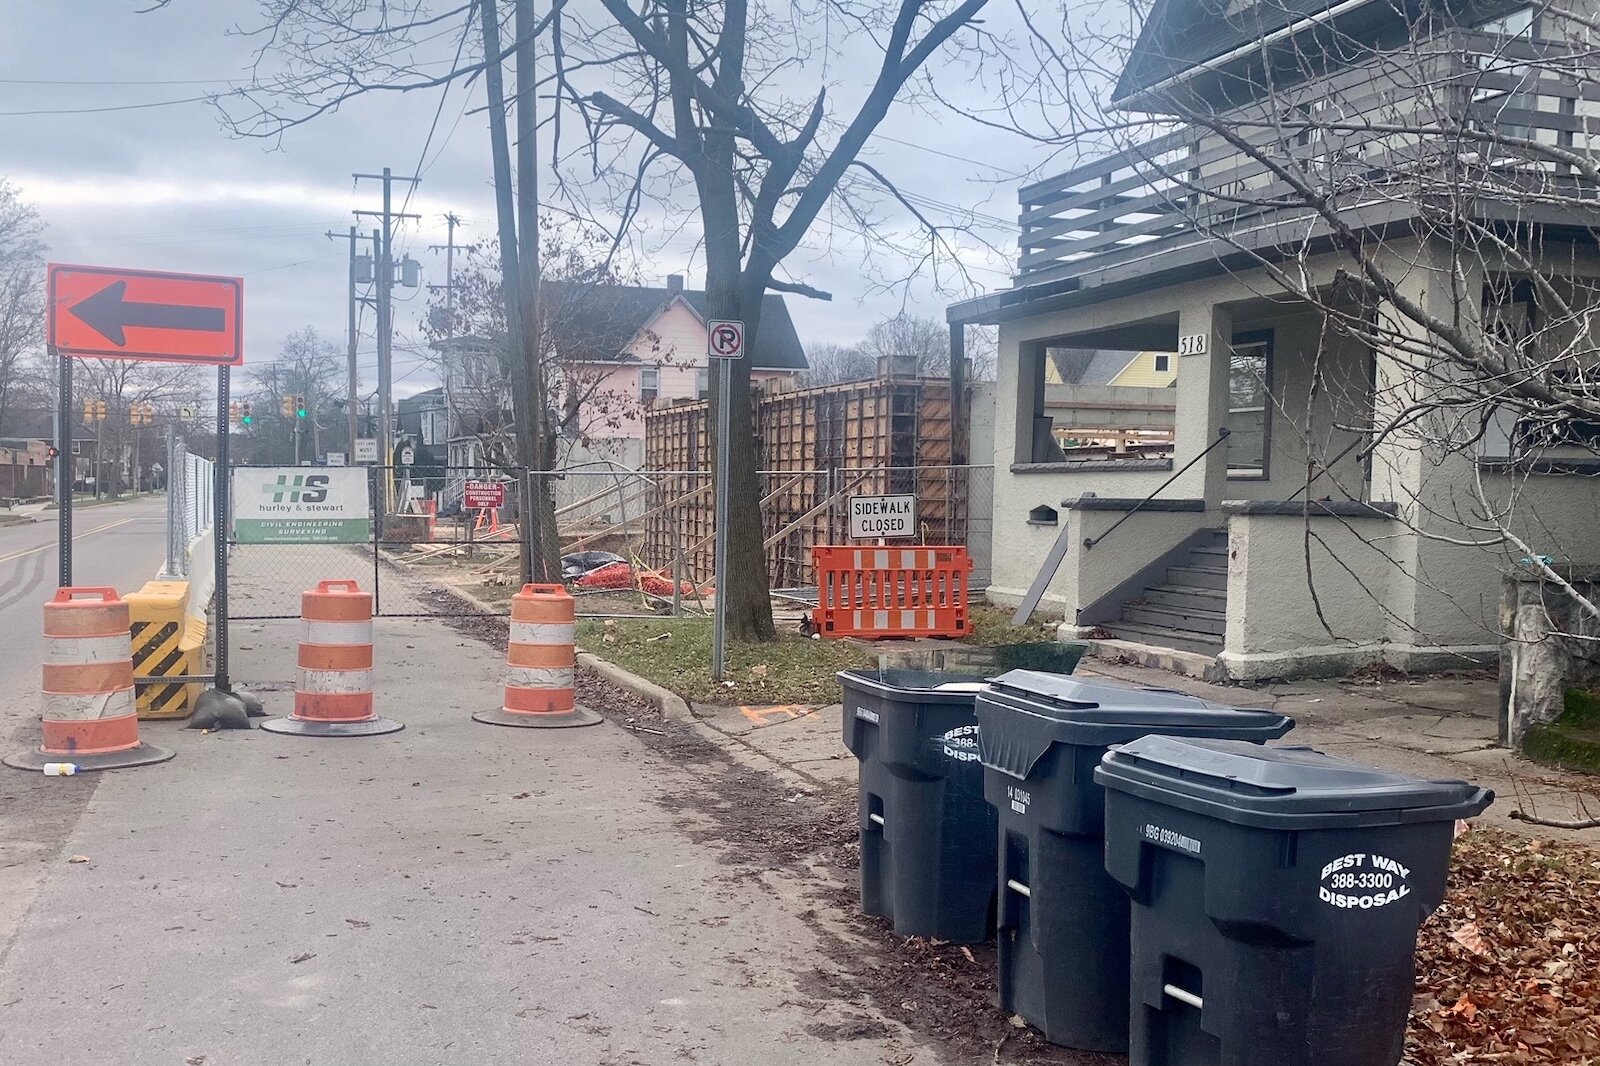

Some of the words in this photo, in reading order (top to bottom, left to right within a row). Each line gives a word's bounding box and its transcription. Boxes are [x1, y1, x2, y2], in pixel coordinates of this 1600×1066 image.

[1180, 335, 1203, 355] 518
[259, 504, 292, 512] hurley
[295, 504, 302, 512] &
[306, 504, 344, 512] stewart
[855, 501, 910, 515] SIDEWALK
[861, 519, 904, 532] CLOSED
[944, 725, 979, 740] BEST
[1320, 853, 1366, 880] BEST
[1371, 854, 1411, 879] WAY
[1330, 872, 1393, 889] 388-3300
[1319, 883, 1411, 909] DISPOSAL
